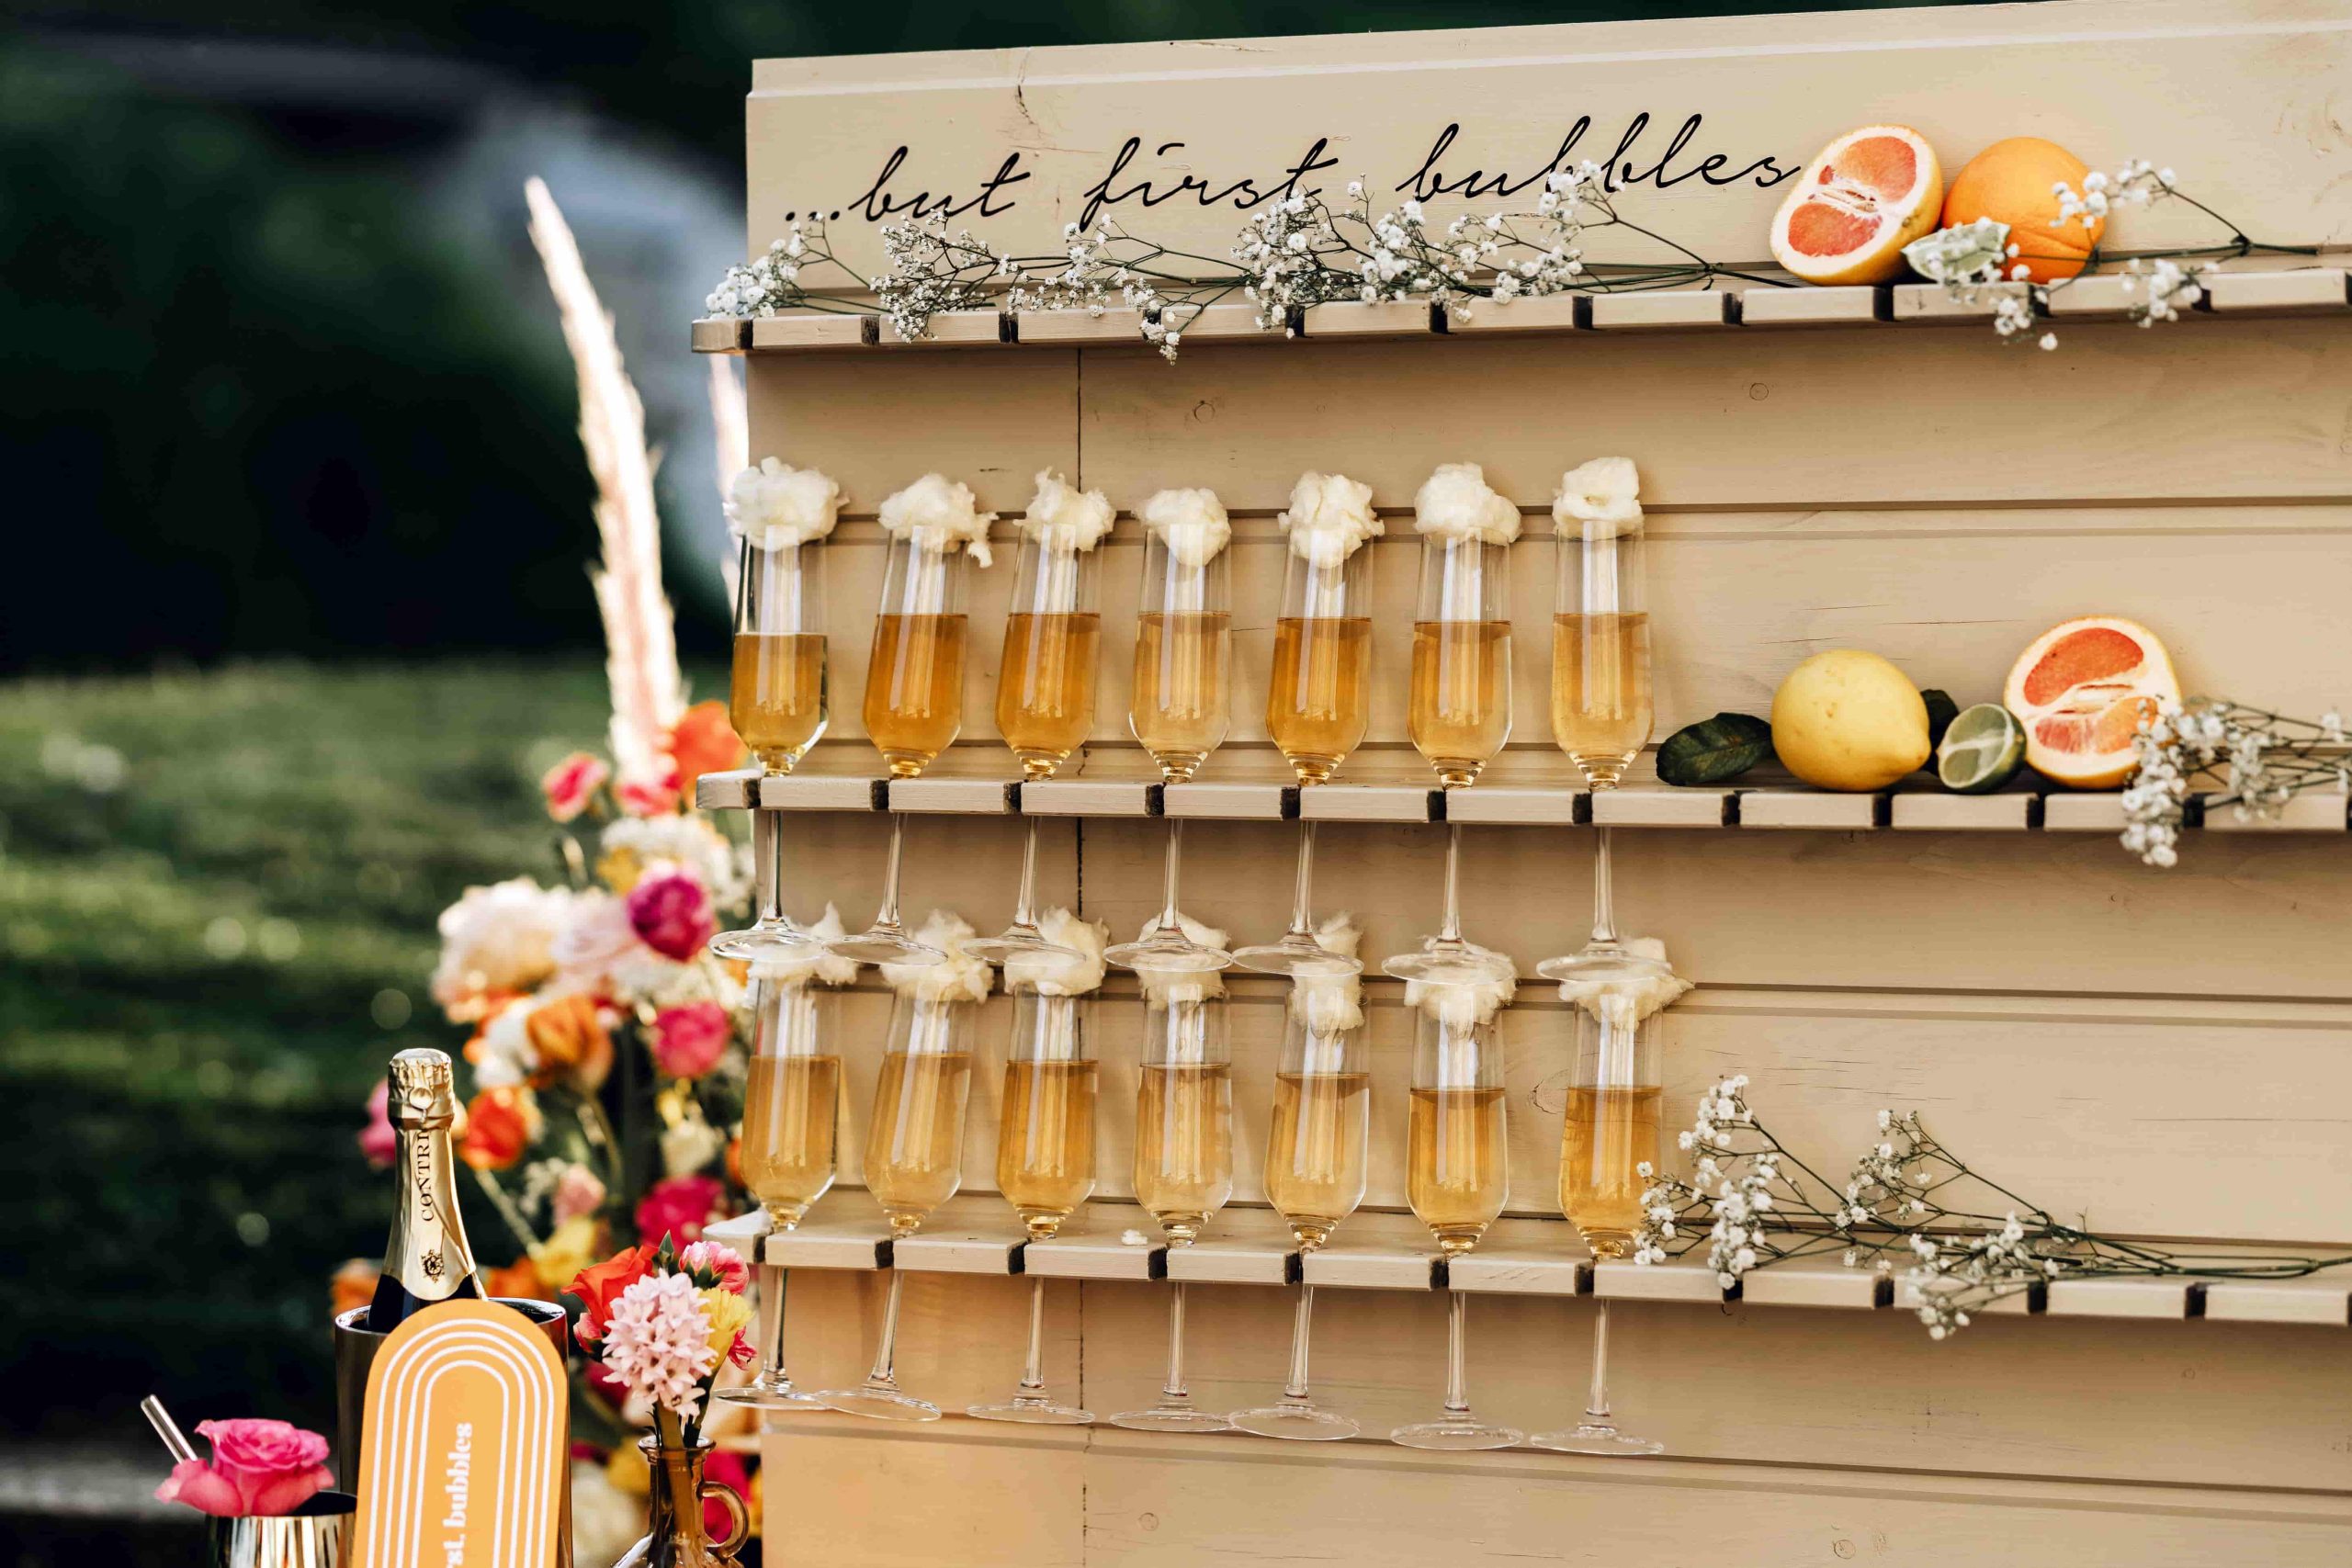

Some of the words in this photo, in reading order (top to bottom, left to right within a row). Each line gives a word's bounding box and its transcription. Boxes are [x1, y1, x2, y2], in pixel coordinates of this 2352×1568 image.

[1079, 137, 1339, 233] first
[1396, 112, 1801, 203] bubbles
[443, 1423, 471, 1528] bubbles
